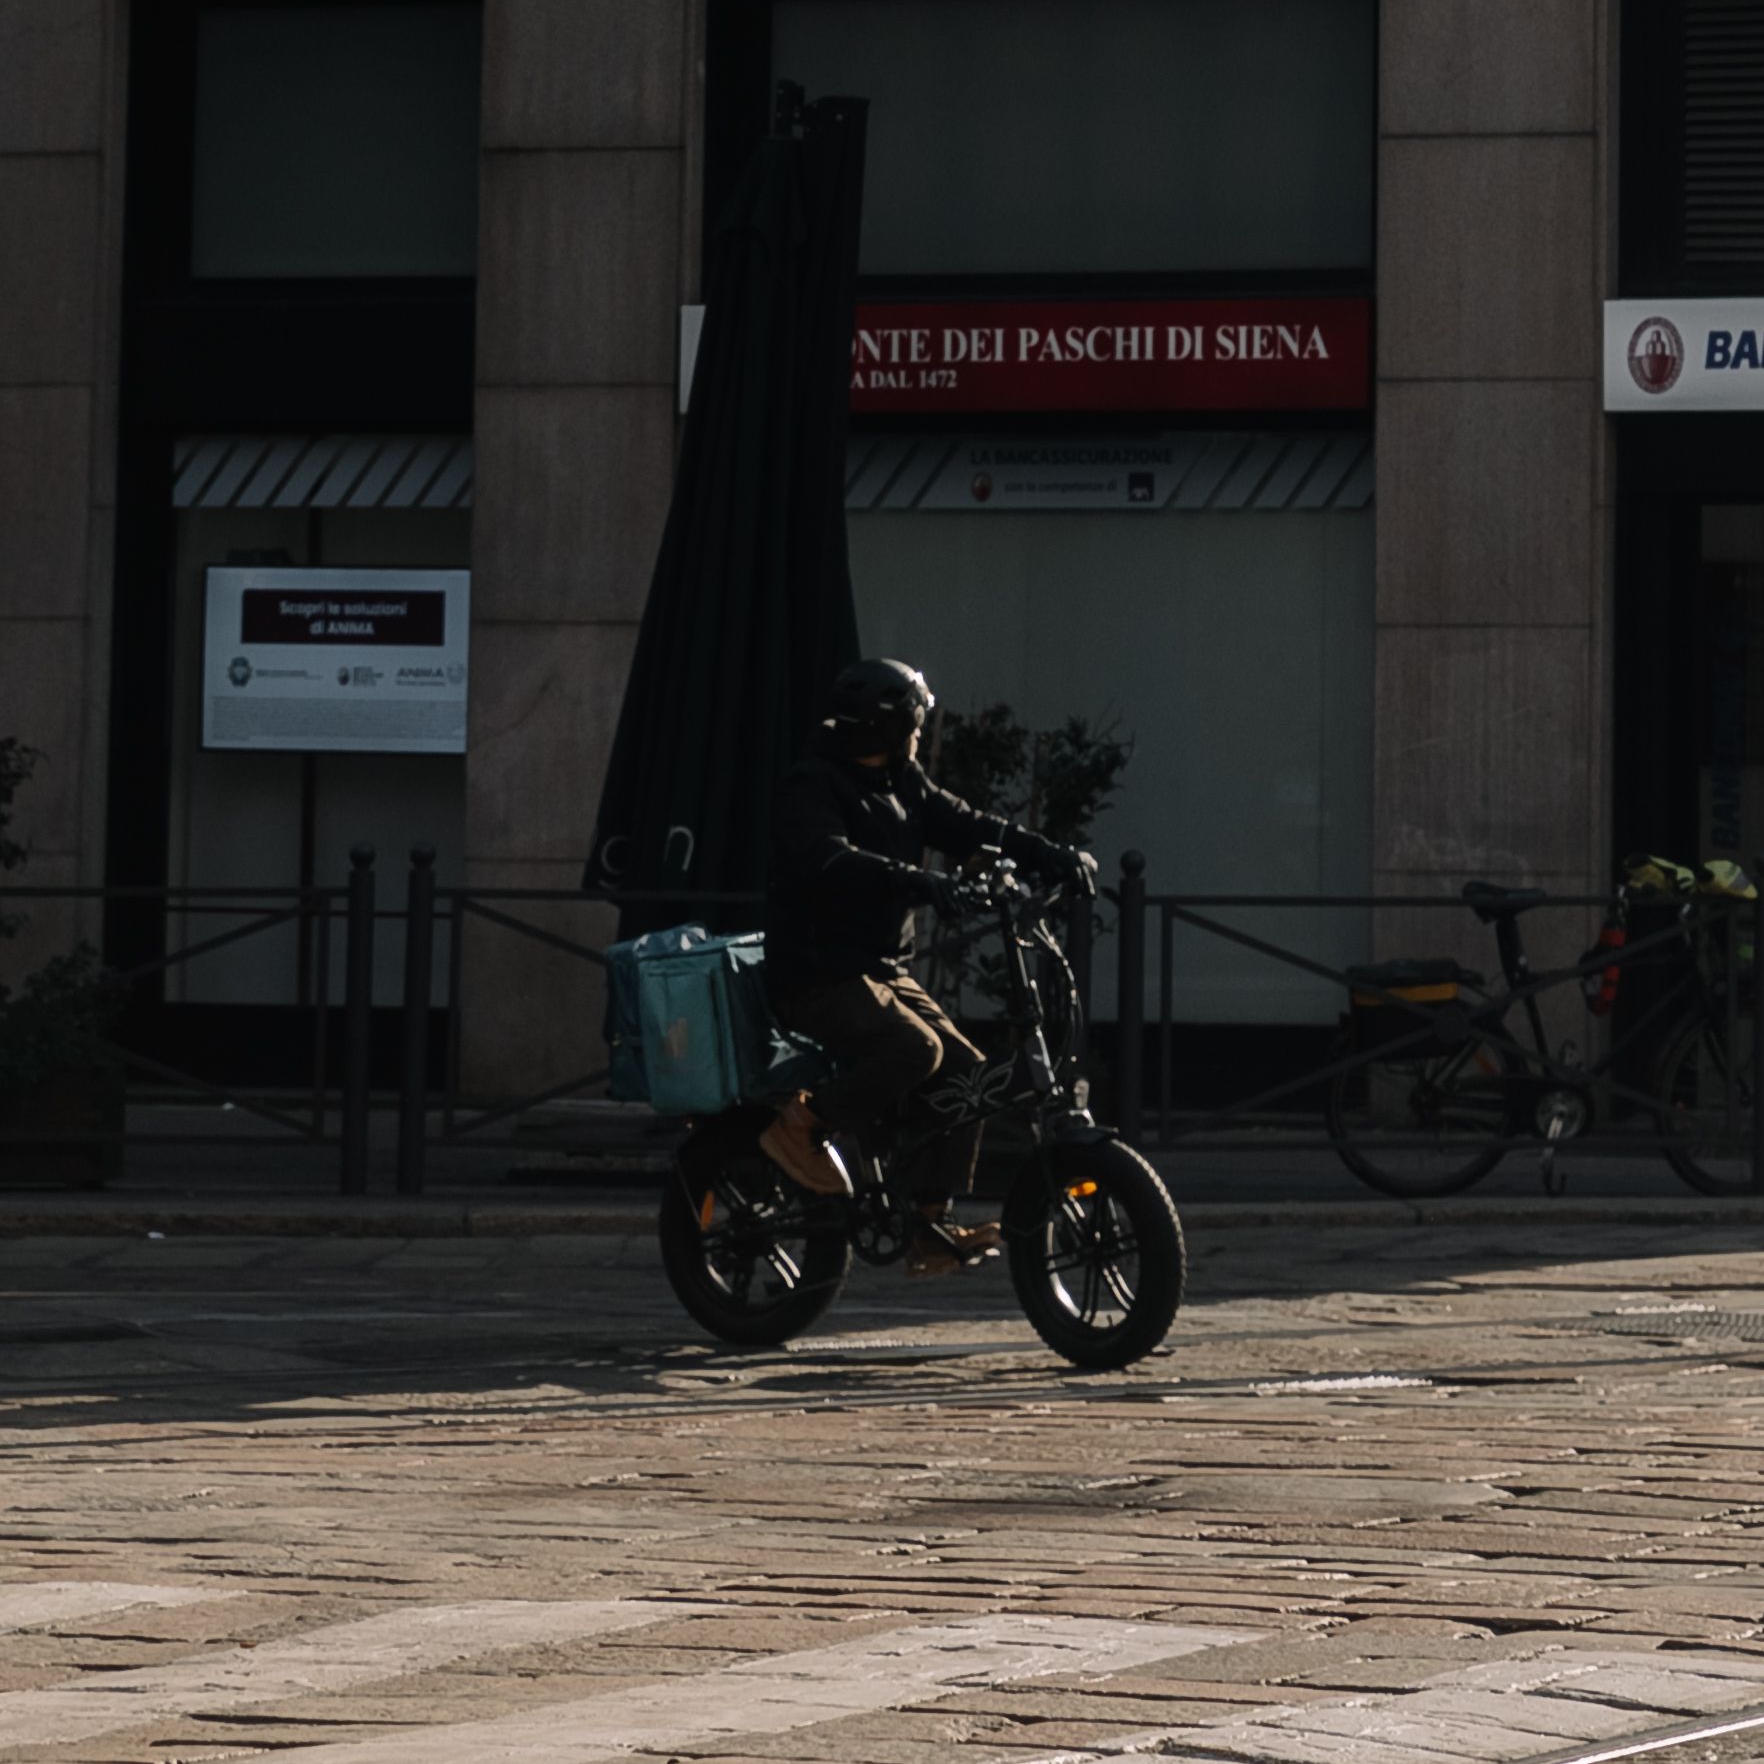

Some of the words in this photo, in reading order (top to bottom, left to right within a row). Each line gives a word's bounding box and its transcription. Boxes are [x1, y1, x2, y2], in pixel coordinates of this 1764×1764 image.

[850, 328, 932, 364] NTE
[942, 327, 1005, 363] DEI
[1017, 326, 1155, 362] PASCHI
[1167, 325, 1205, 360] DI
[1215, 324, 1330, 360] SIENA
[869, 370, 913, 389] DAL
[918, 369, 958, 389] 1472
[970, 448, 991, 465] LA
[994, 446, 1173, 465] BANCASSICURAZIONE
[279, 601, 326, 618] Scopri
[343, 601, 408, 616] soluzioni
